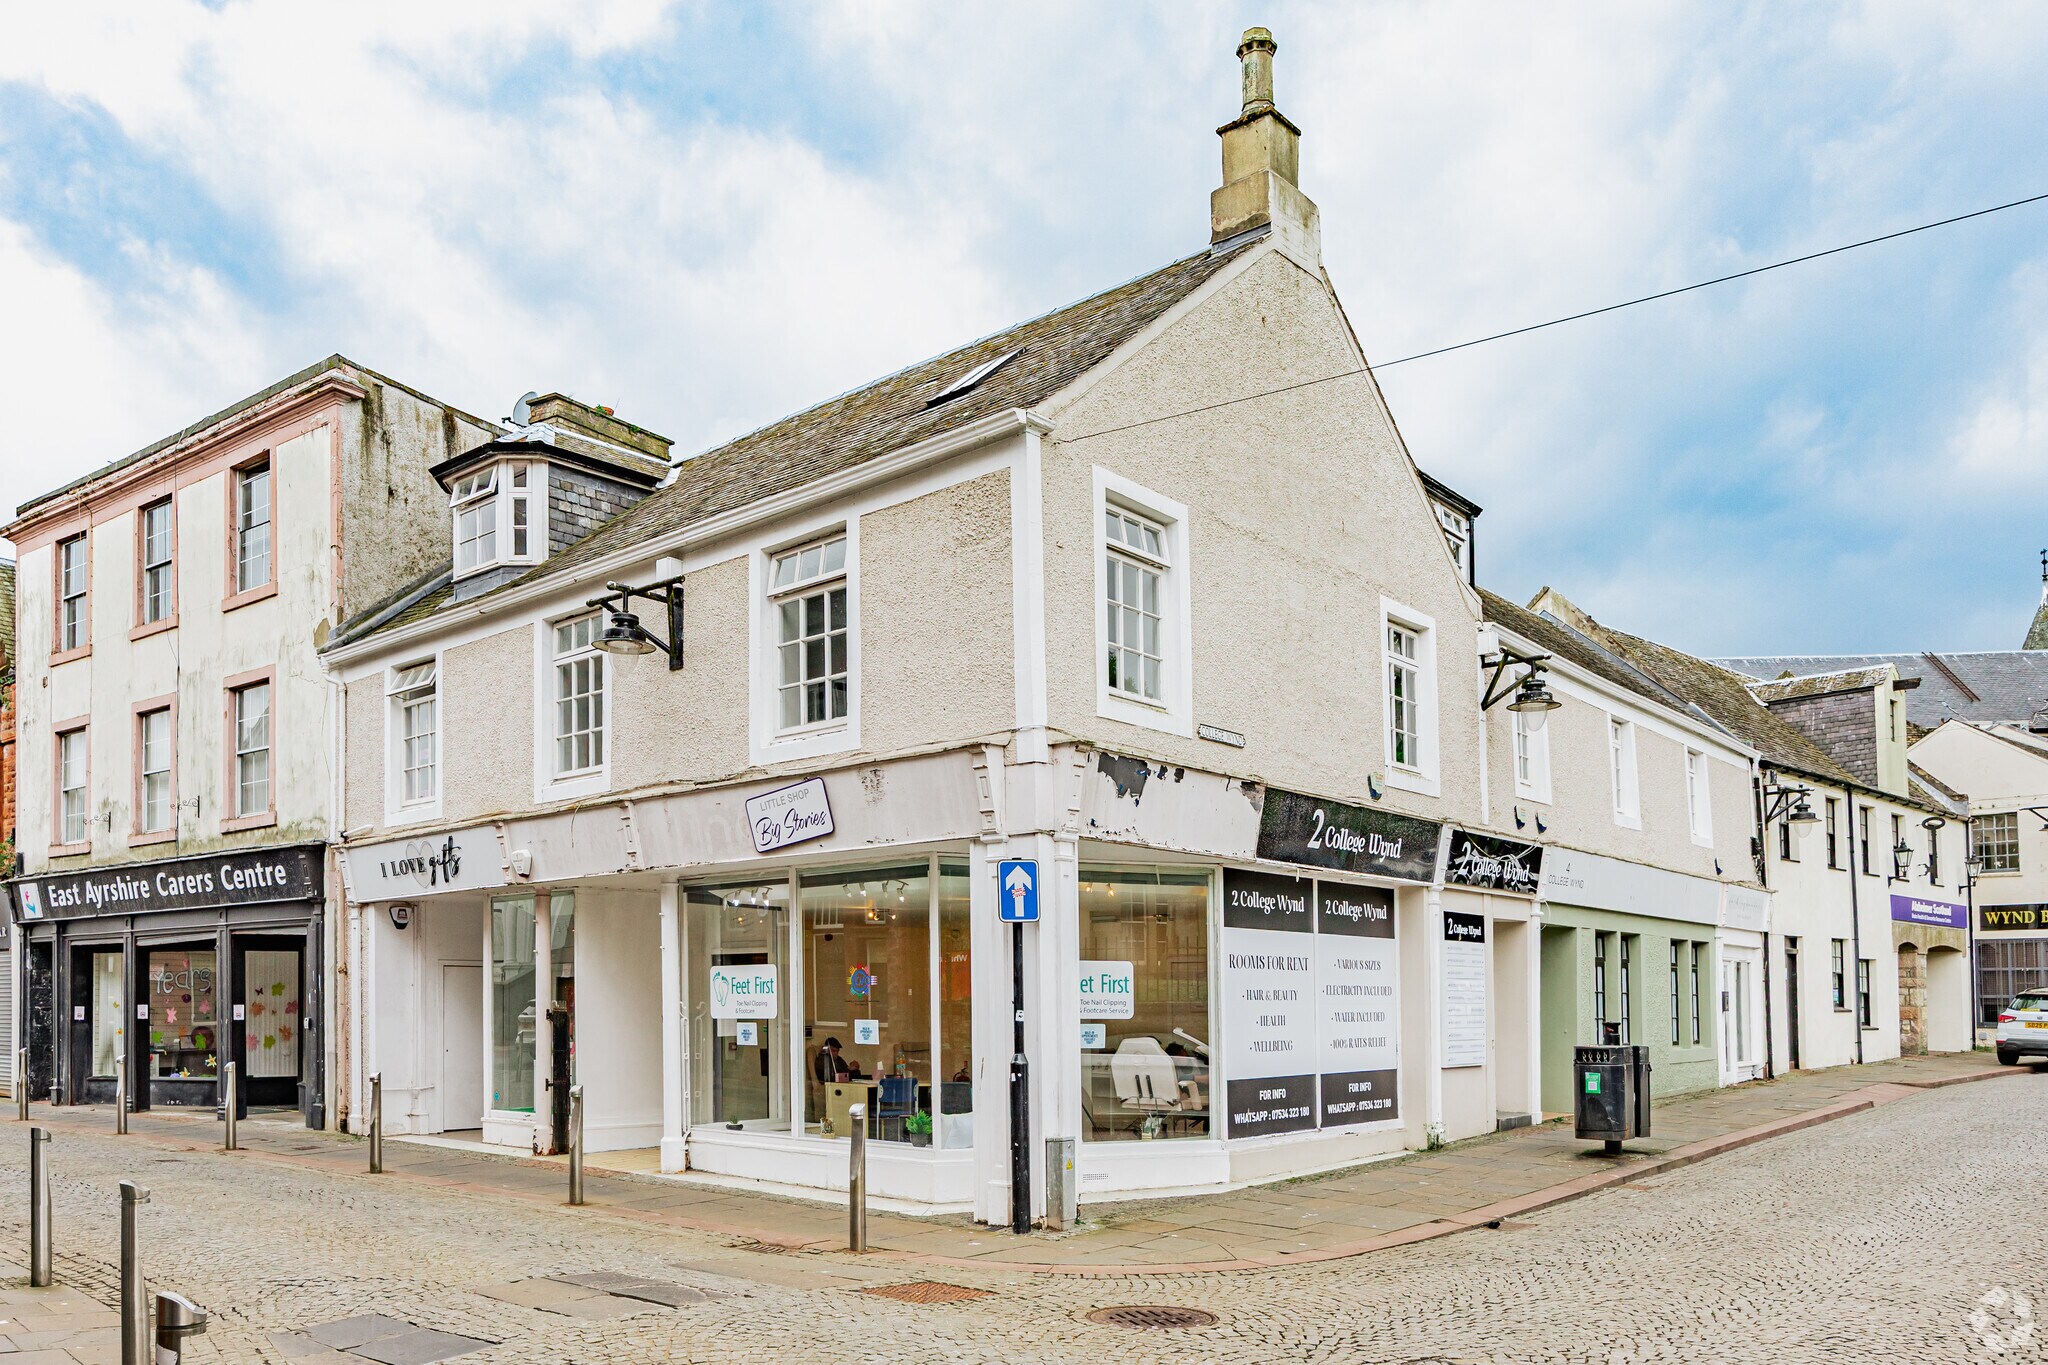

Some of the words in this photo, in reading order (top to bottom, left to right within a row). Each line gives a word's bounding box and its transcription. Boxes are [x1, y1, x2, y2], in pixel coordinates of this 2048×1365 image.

[759, 795, 786, 812] LITTLE
[788, 788, 810, 804] SHOP
[756, 816, 780, 846] Big
[783, 808, 827, 839] Stories
[1307, 808, 1325, 849] 2
[1325, 826, 1366, 855] College
[1368, 833, 1402, 863] Wynd
[380, 862, 388, 878] I
[390, 857, 427, 877] LOVE
[428, 835, 462, 886] gifts
[1458, 841, 1472, 875] 2
[1471, 857, 1502, 880] College
[1503, 861, 1530, 886] Wynd
[1565, 863, 1571, 873] 4
[48, 884, 81, 908] East
[85, 875, 150, 909] Ayrshire
[156, 871, 213, 898] Carers
[220, 862, 287, 891] Centre
[1548, 874, 1569, 887] COLLEGE
[1570, 878, 1585, 889] WYND
[1231, 890, 1239, 906] 2
[1240, 890, 1276, 914] College
[1277, 894, 1305, 914] Wynd
[1325, 900, 1331, 914] 2
[1332, 900, 1362, 922] College
[1363, 903, 1387, 921] Wynd
[1985, 910, 2036, 924] WYND
[1447, 918, 1453, 935] 2
[1453, 924, 1468, 936] College
[1468, 925, 1482, 938] Wynd
[1229, 954, 1265, 969] ROOMS
[1267, 955, 1285, 970] FOR
[1287, 956, 1309, 971] RENT
[1337, 959, 1364, 970] VARIOUS
[1364, 960, 1381, 971] SIZES
[153, 968, 211, 994] Years
[731, 977, 751, 995] Feet
[754, 976, 775, 994] First
[1080, 975, 1094, 993] et
[1101, 974, 1130, 993] First
[1246, 989, 1264, 1001] HAIR
[1265, 991, 1272, 1001] &
[1273, 989, 1298, 1001] BEAUTY
[1325, 985, 1363, 996] ELECTRICITY
[1364, 985, 1392, 996] INCLUDED
[1103, 999, 1127, 1007] Clipping
[1260, 1015, 1286, 1026] HEALTH
[1334, 1012, 1355, 1022] WATER
[1356, 1012, 1385, 1022] INCLUDED
[1254, 1040, 1293, 1052] WELLBEING
[1348, 1037, 1367, 1048] RATES
[1368, 1036, 1386, 1048] RELIEF
[1259, 1089, 1271, 1101] FOR
[1272, 1088, 1286, 1100] INFO
[1349, 1083, 1359, 1093] FOR
[1360, 1082, 1371, 1091] INFO
[1327, 1102, 1355, 1114] WHATSAPP
[1359, 1101, 1373, 1110] 07534
[1373, 1099, 1382, 1109] 323
[1383, 1098, 1391, 1108] 180
[1234, 1112, 1268, 1124] WHATSAPP
[1271, 1108, 1289, 1120] 07534
[1289, 1107, 1300, 1118] 323
[1300, 1106, 1310, 1117] 180
